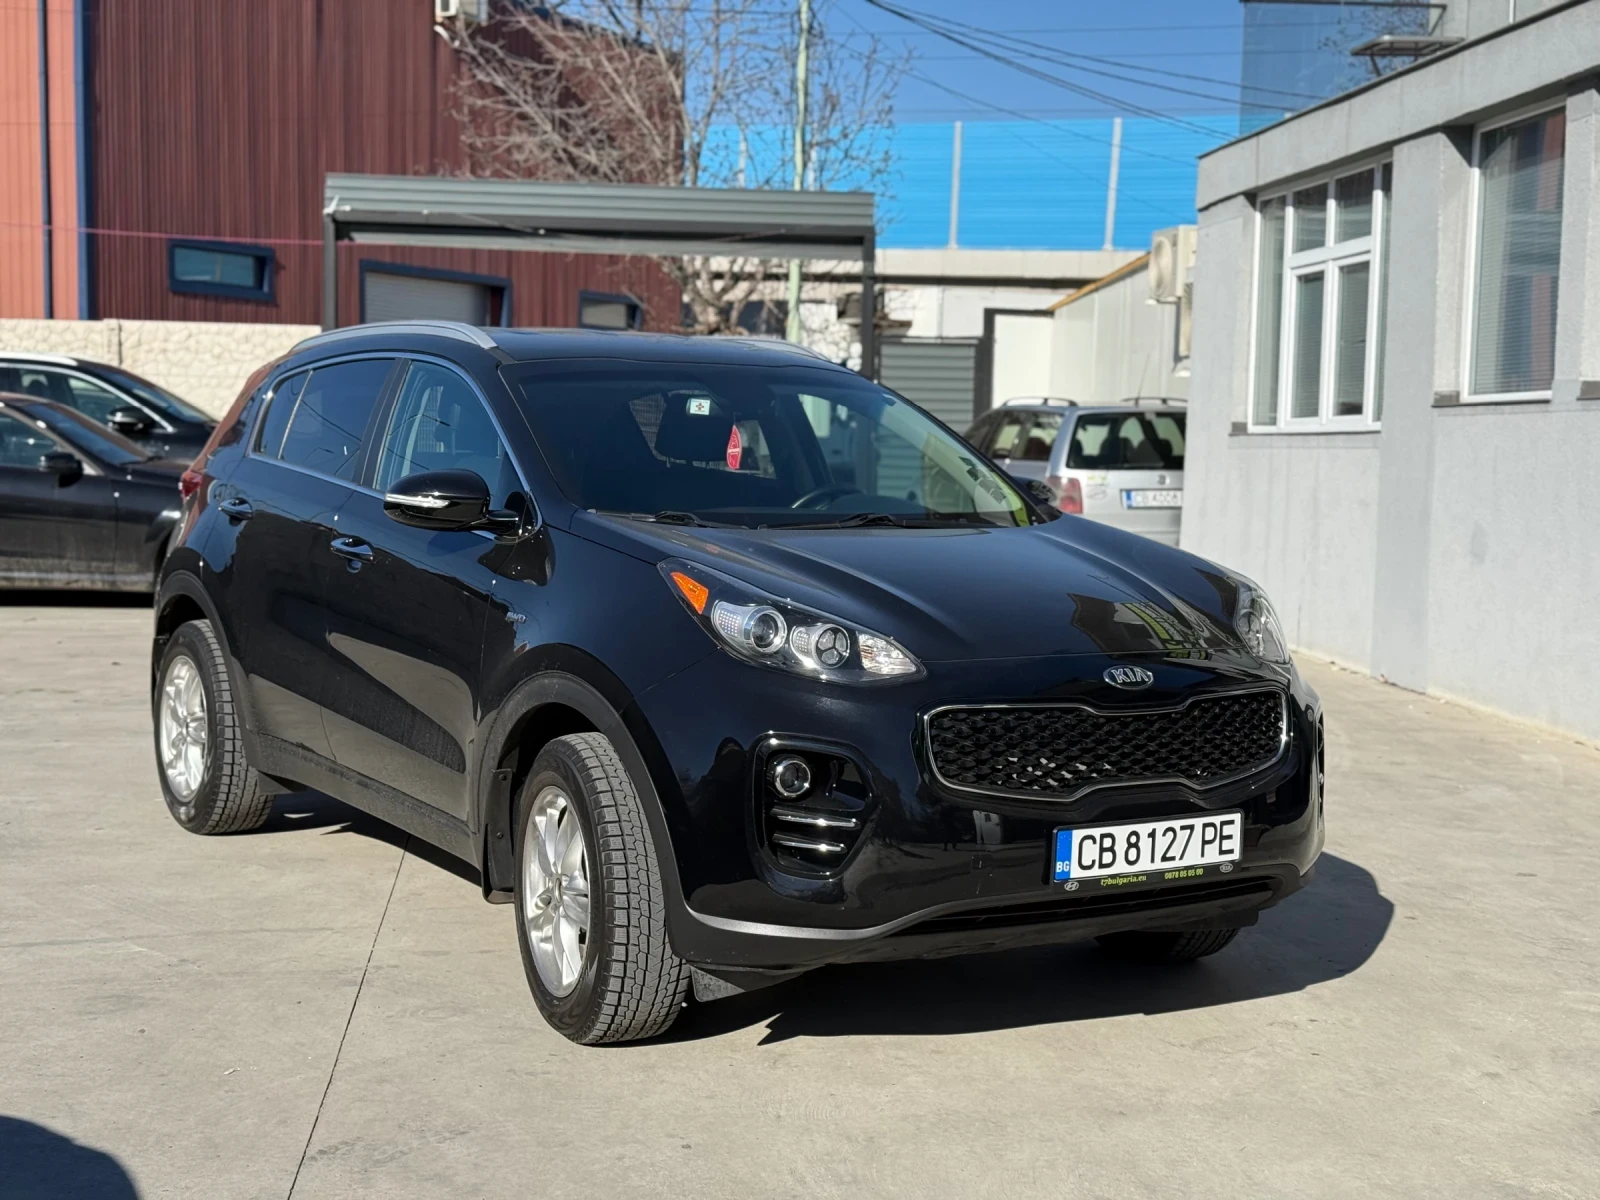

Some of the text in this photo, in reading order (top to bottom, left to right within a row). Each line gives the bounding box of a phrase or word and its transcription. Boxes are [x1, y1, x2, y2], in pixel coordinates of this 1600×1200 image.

[1111, 668, 1149, 683] KIA
[1077, 819, 1235, 871] CB 8127 PE
[1056, 861, 1070, 872] BG
